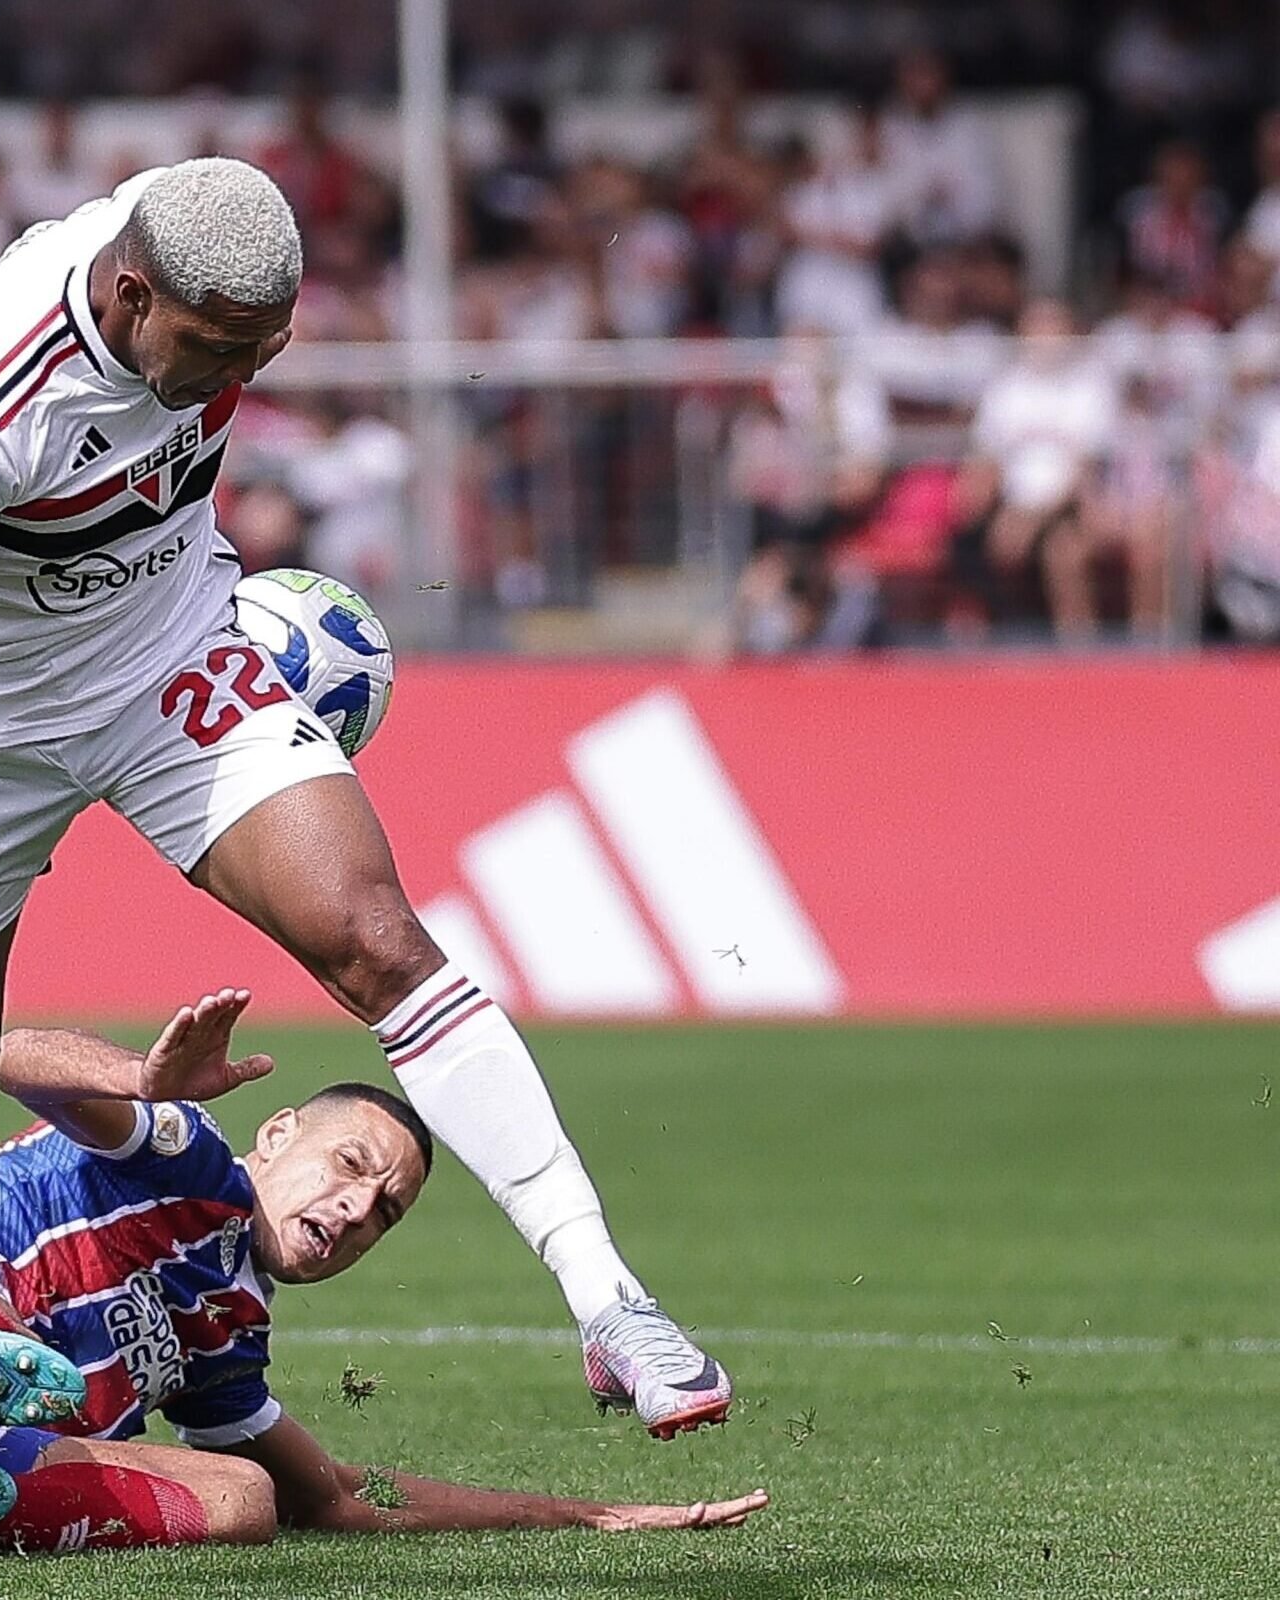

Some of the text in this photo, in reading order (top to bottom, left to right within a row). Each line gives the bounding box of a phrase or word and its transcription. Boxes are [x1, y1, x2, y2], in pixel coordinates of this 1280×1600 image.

[132, 428, 198, 480] SPFC
[160, 646, 293, 749] 22
[106, 1303, 142, 1348] da
[130, 1272, 185, 1398] Esporte
